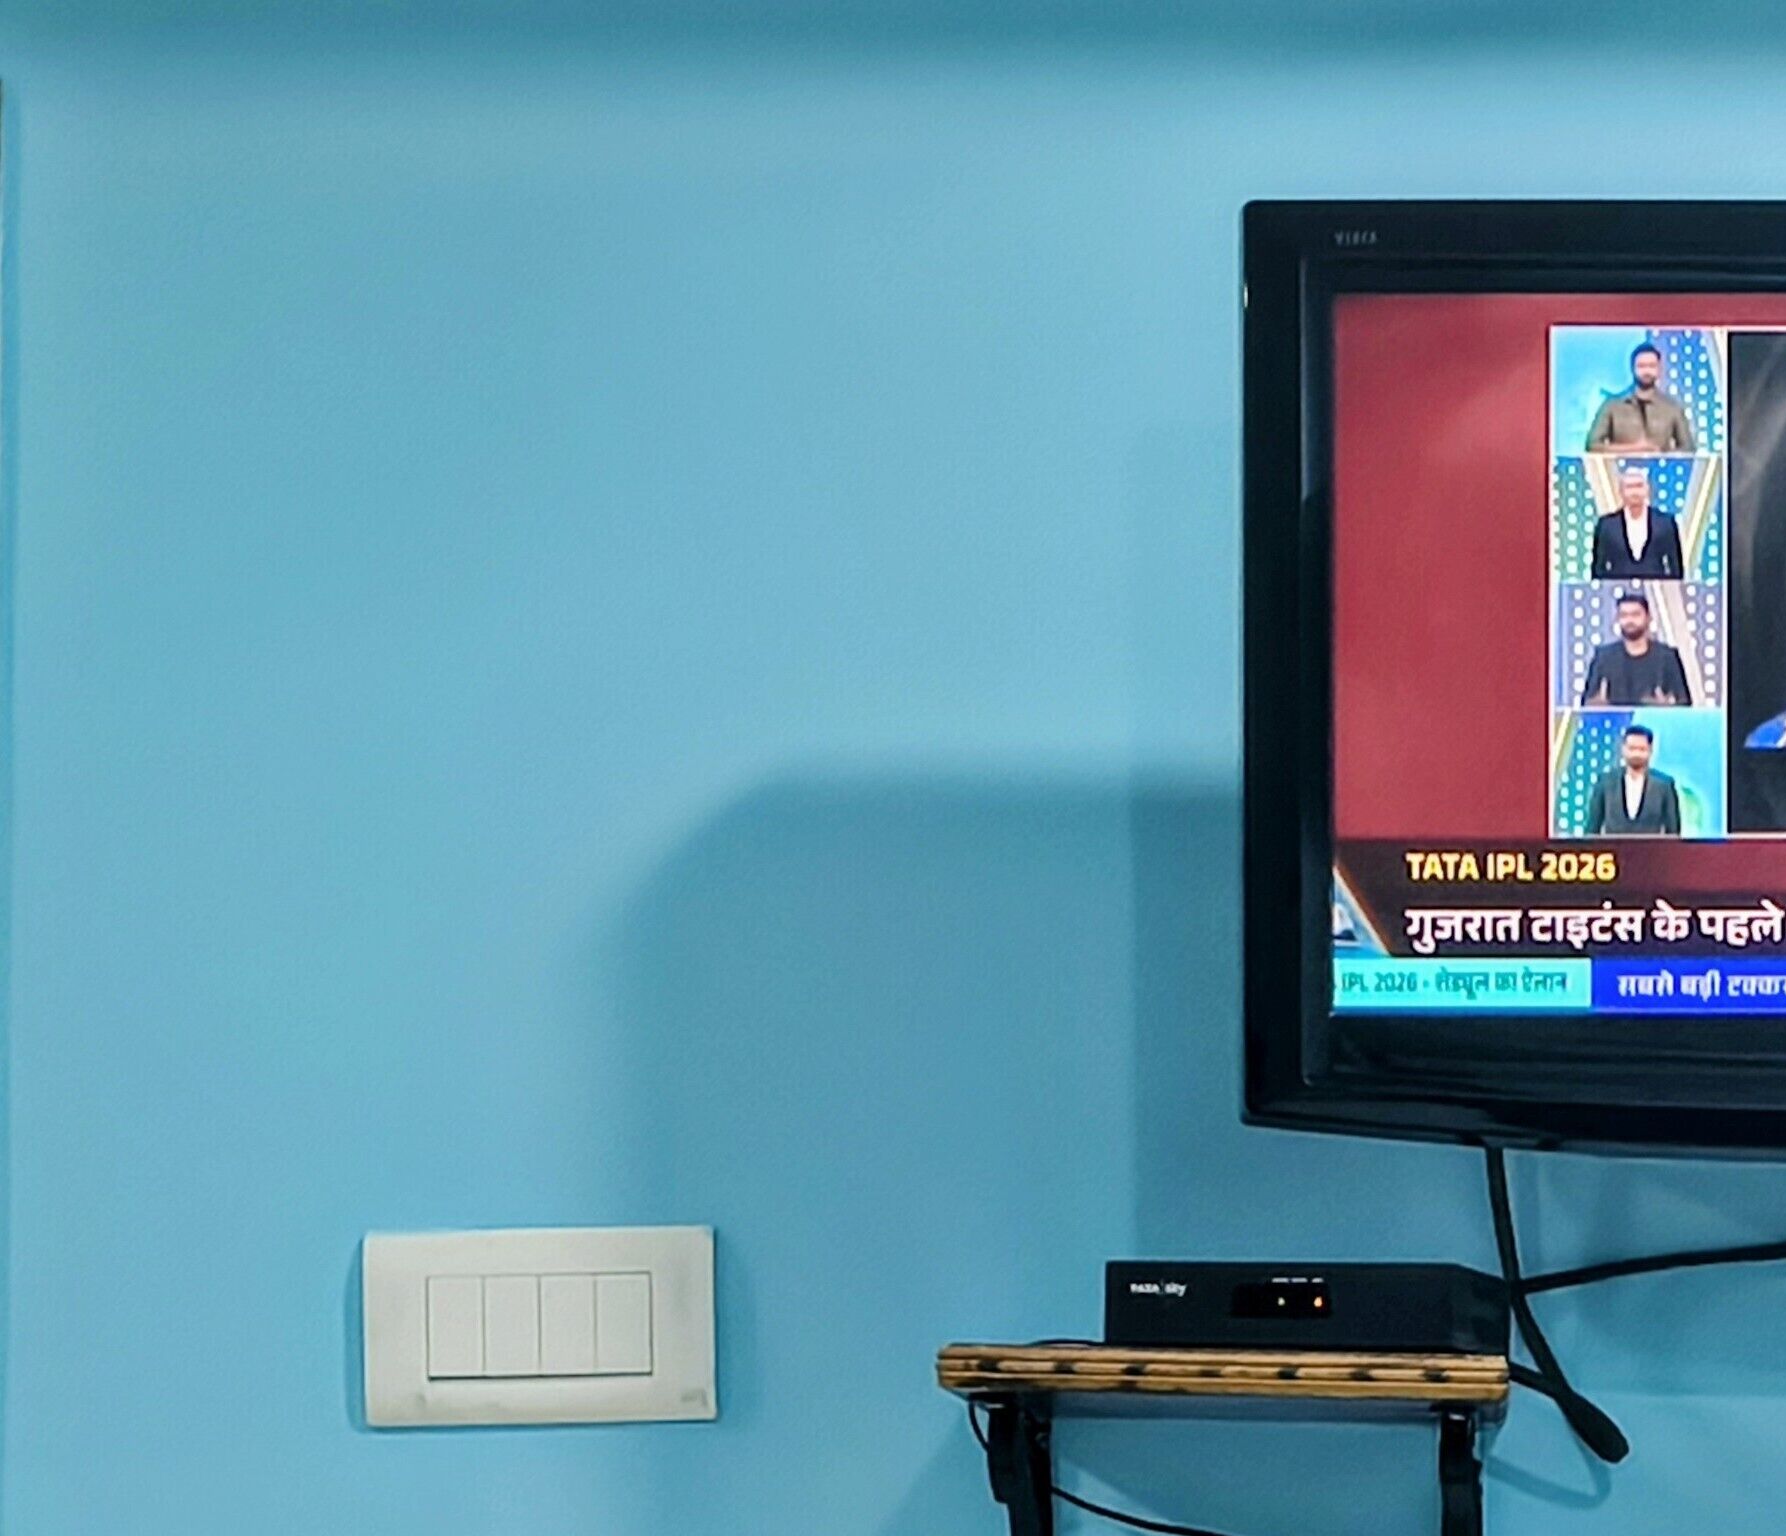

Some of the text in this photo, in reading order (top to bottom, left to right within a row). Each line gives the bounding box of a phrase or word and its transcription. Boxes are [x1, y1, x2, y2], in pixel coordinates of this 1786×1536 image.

[1405, 853, 1617, 881] TATA IPL 2026
[1404, 909, 1523, 955] गुजरात
[1528, 900, 1646, 950] टाइटंस
[1651, 898, 1692, 942] के
[1697, 899, 1786, 947] पहले
[1617, 969, 1674, 997] सबसे
